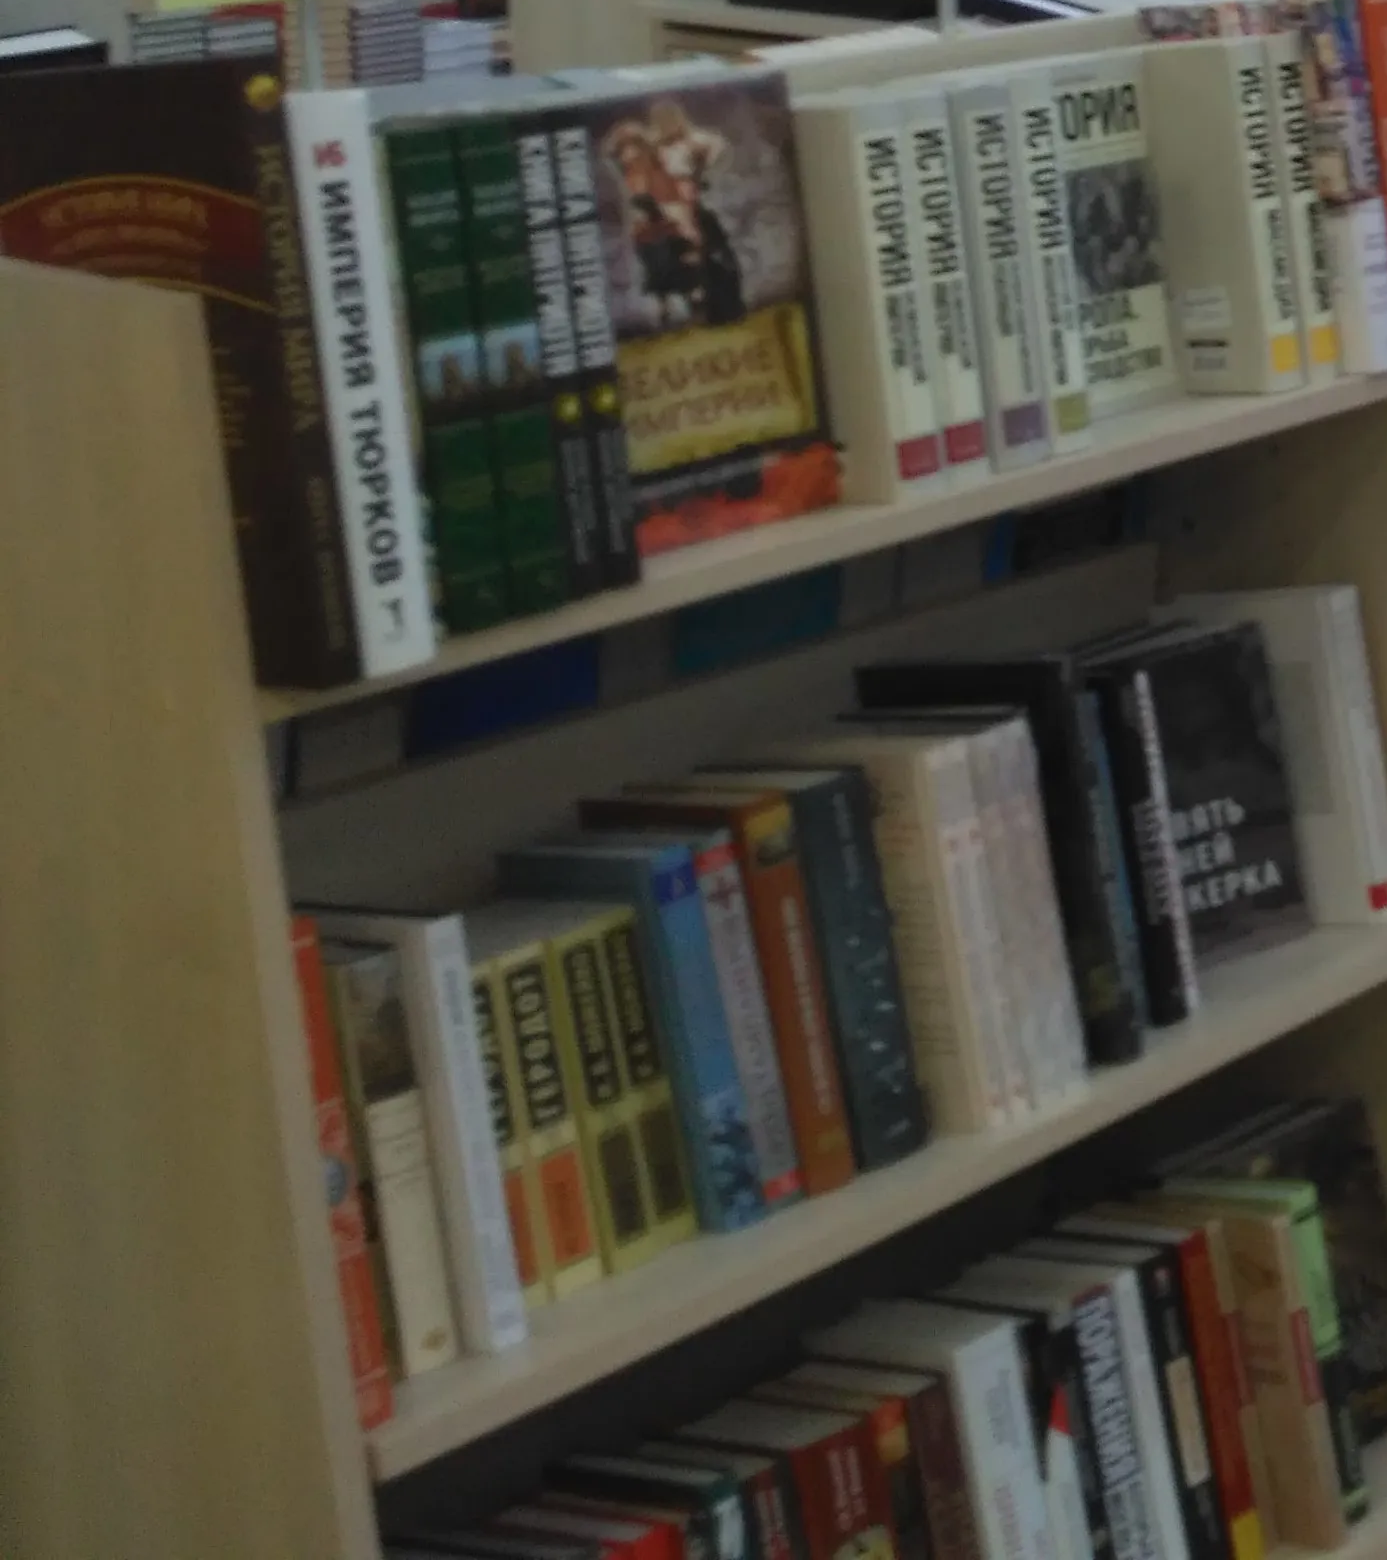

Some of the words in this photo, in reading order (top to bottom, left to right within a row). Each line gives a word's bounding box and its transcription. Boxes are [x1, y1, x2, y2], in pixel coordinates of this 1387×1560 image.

[1024, 105, 1067, 252] ИСТОРИЯ
[1055, 80, 1141, 141] ОРИЯ
[864, 136, 915, 290] ИСТОРИЯ
[913, 126, 962, 279] ИСТОРИЯ
[973, 113, 1020, 263] ИСТОРИЯ
[319, 178, 376, 392] ИМПЕРИЯ
[349, 403, 403, 589] ТЮРКОВ
